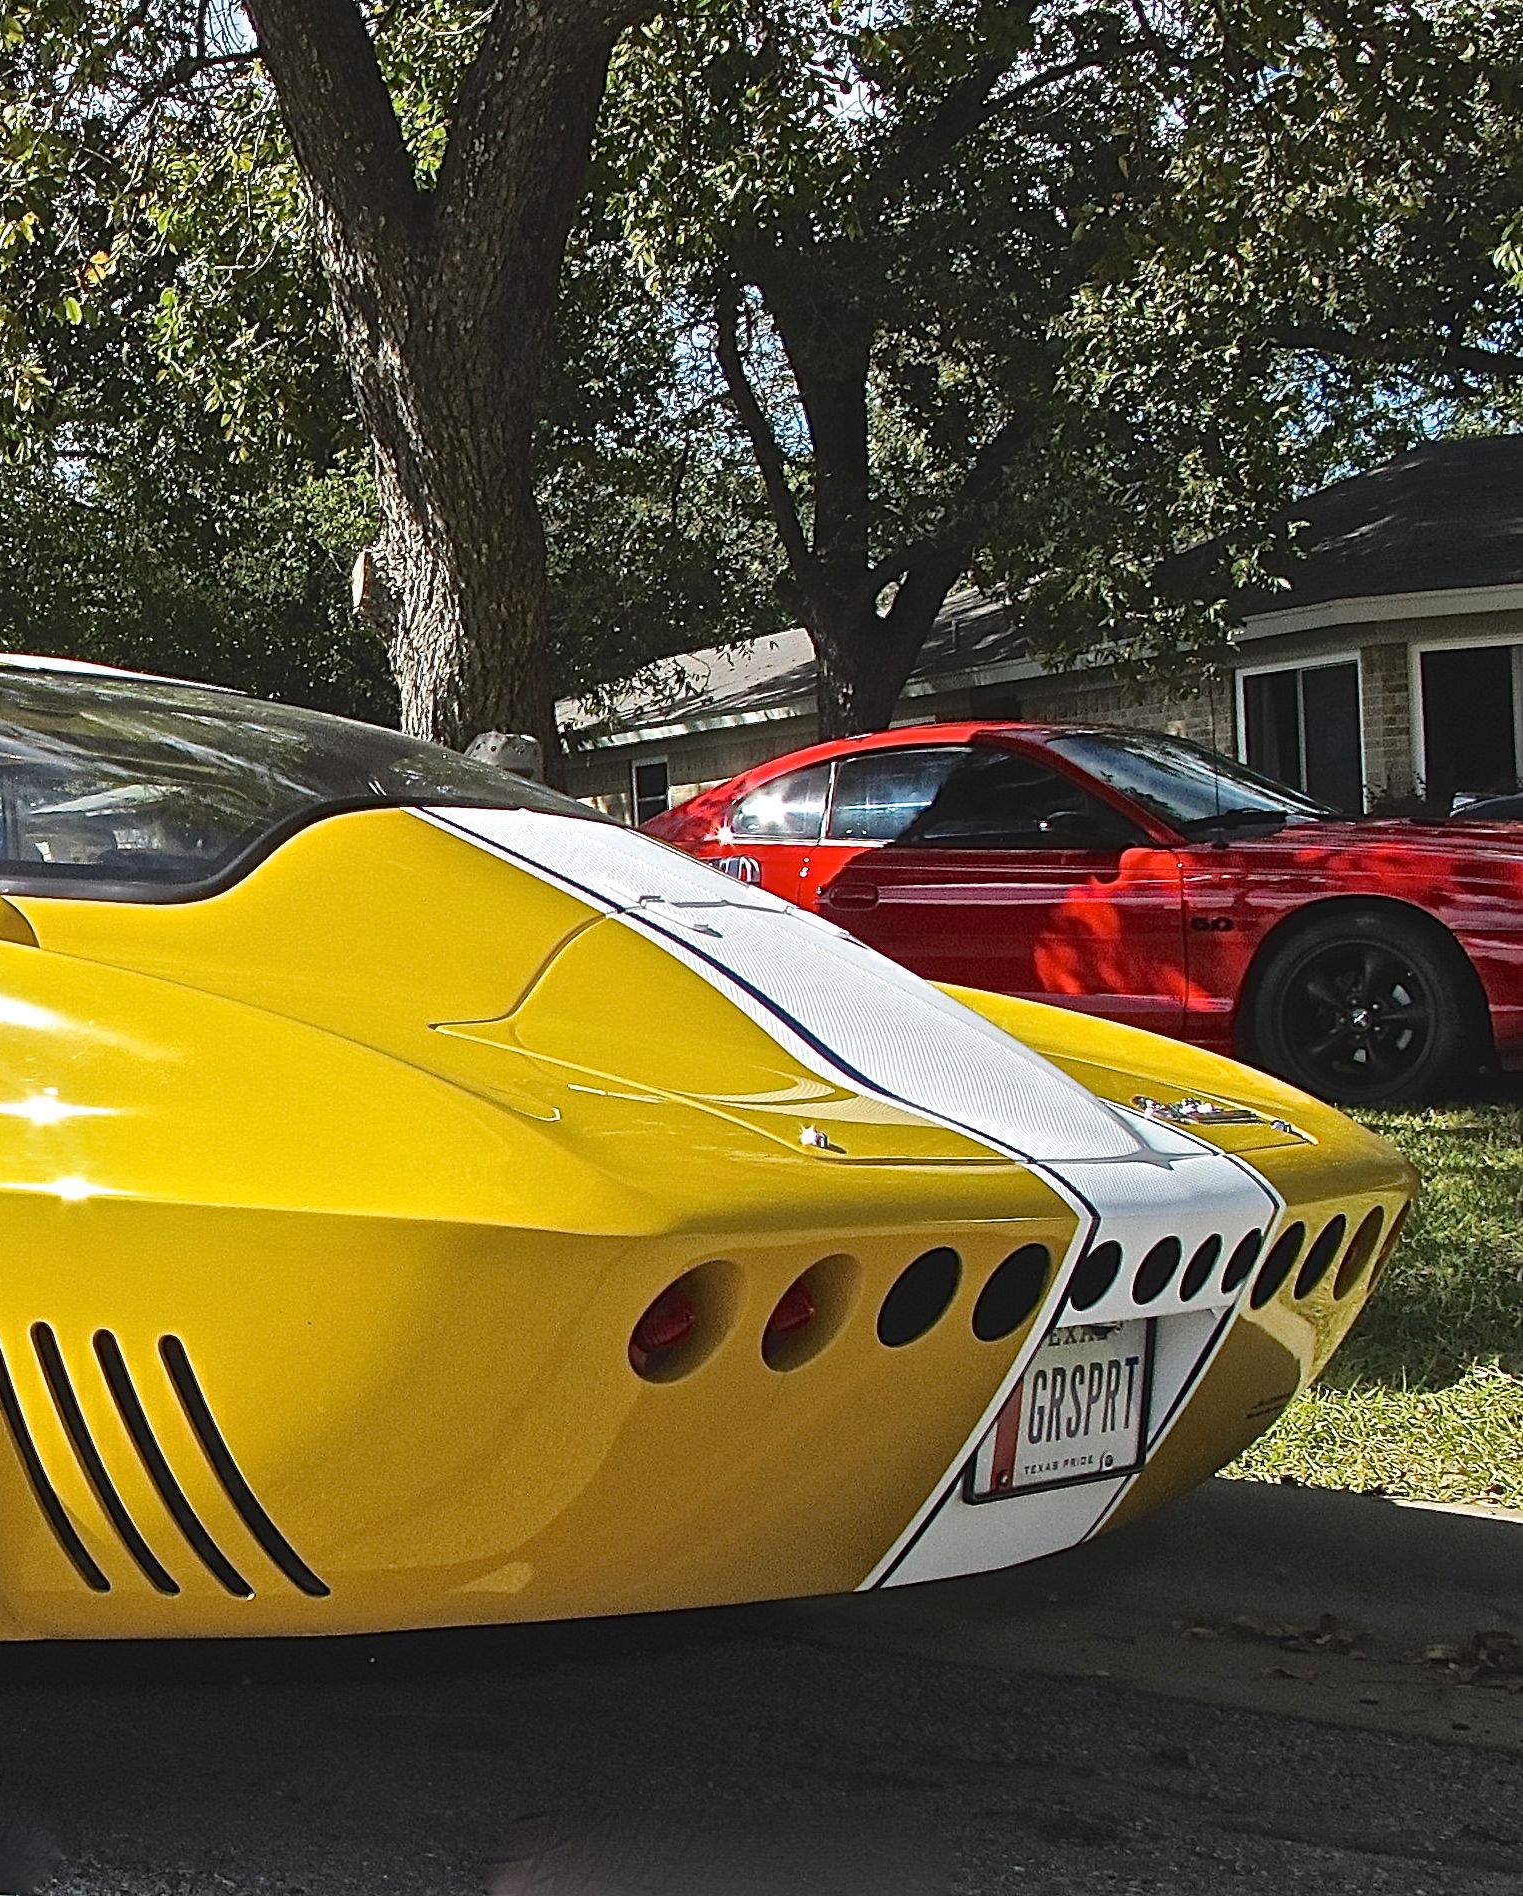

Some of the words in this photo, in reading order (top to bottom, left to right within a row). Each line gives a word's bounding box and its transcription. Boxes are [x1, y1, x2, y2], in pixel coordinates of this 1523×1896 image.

[1027, 1356, 1139, 1444] GRSPRT
[1024, 1460, 1059, 1475] TEXAS
[1063, 1454, 1094, 1468] PRIDE
